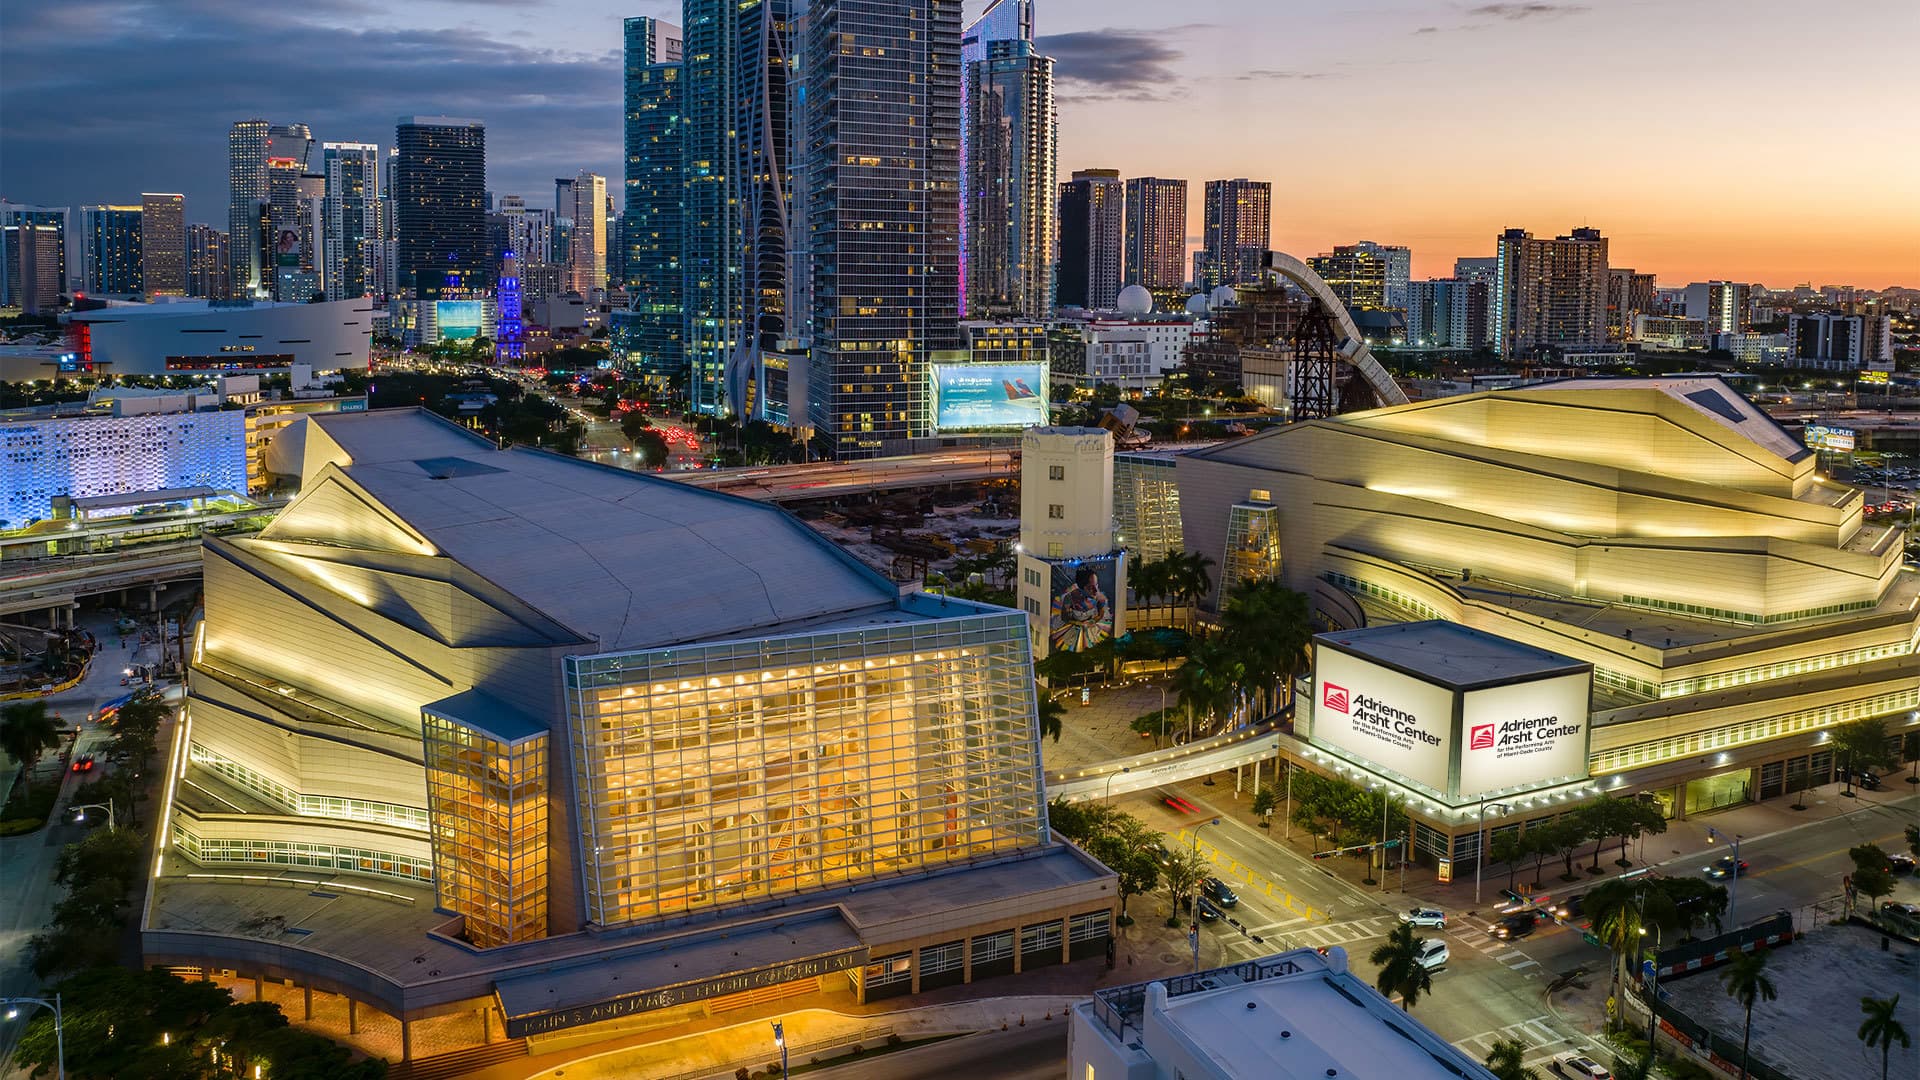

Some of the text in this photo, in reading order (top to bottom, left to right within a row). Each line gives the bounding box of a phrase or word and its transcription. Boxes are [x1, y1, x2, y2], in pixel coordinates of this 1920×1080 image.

[1353, 694, 1416, 724] Adrienne
[1353, 707, 1441, 746] Arsht Center
[1361, 722, 1372, 730] the
[1371, 726, 1402, 741] Performing
[1402, 736, 1415, 745] Arts
[1497, 725, 1581, 747] Arsht Center
[1498, 716, 1557, 734] Adrienne
[1359, 728, 1392, 743] Miami-Dade
[1392, 739, 1413, 750] County
[1514, 741, 1543, 749] Performing
[1503, 749, 1534, 757] Miami-Dade
[590, 1003, 623, 1018] AND
